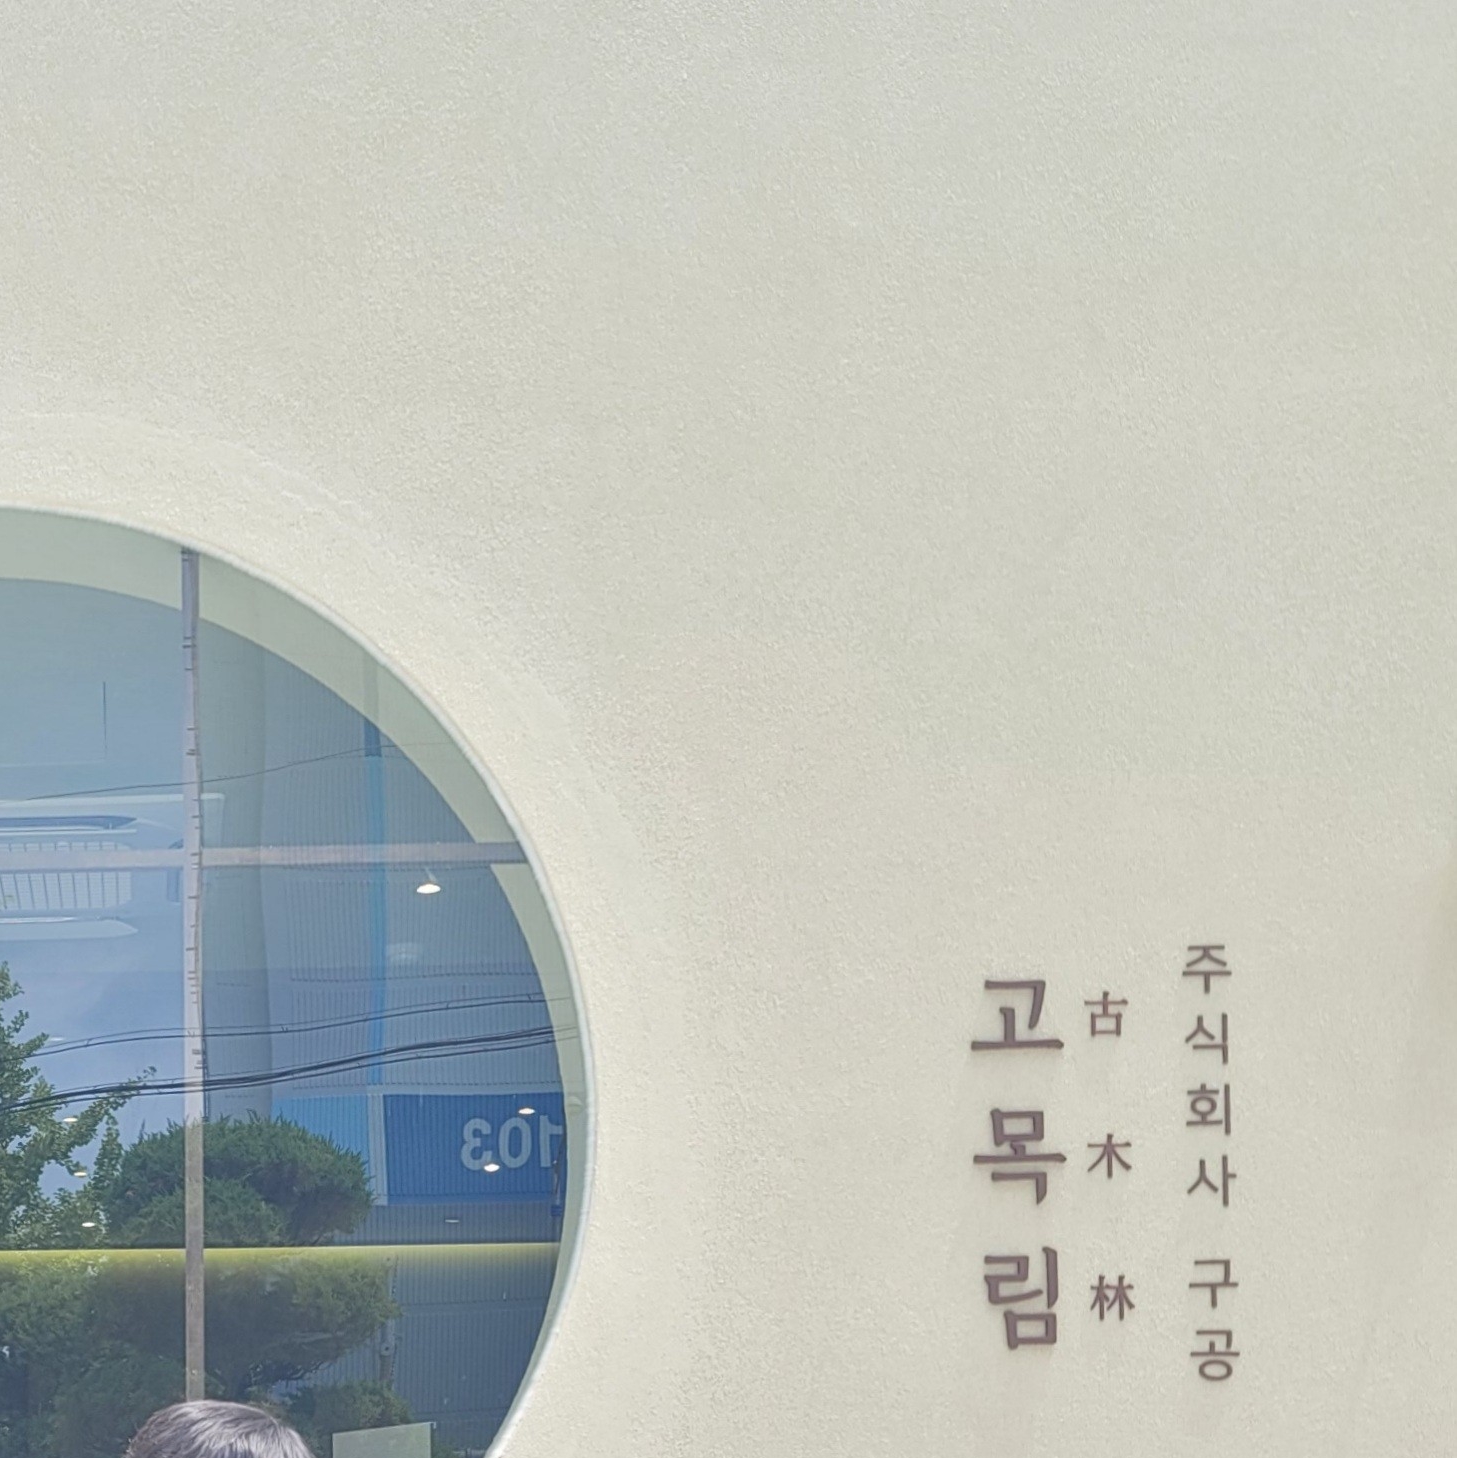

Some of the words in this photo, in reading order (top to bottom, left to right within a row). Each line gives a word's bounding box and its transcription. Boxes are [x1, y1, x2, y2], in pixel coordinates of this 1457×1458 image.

[971, 980, 1067, 1350] 고목림
[1084, 991, 1135, 1321] 古木林
[1182, 944, 1237, 1207] 주식회사
[1188, 1259, 1240, 1381] 구공
